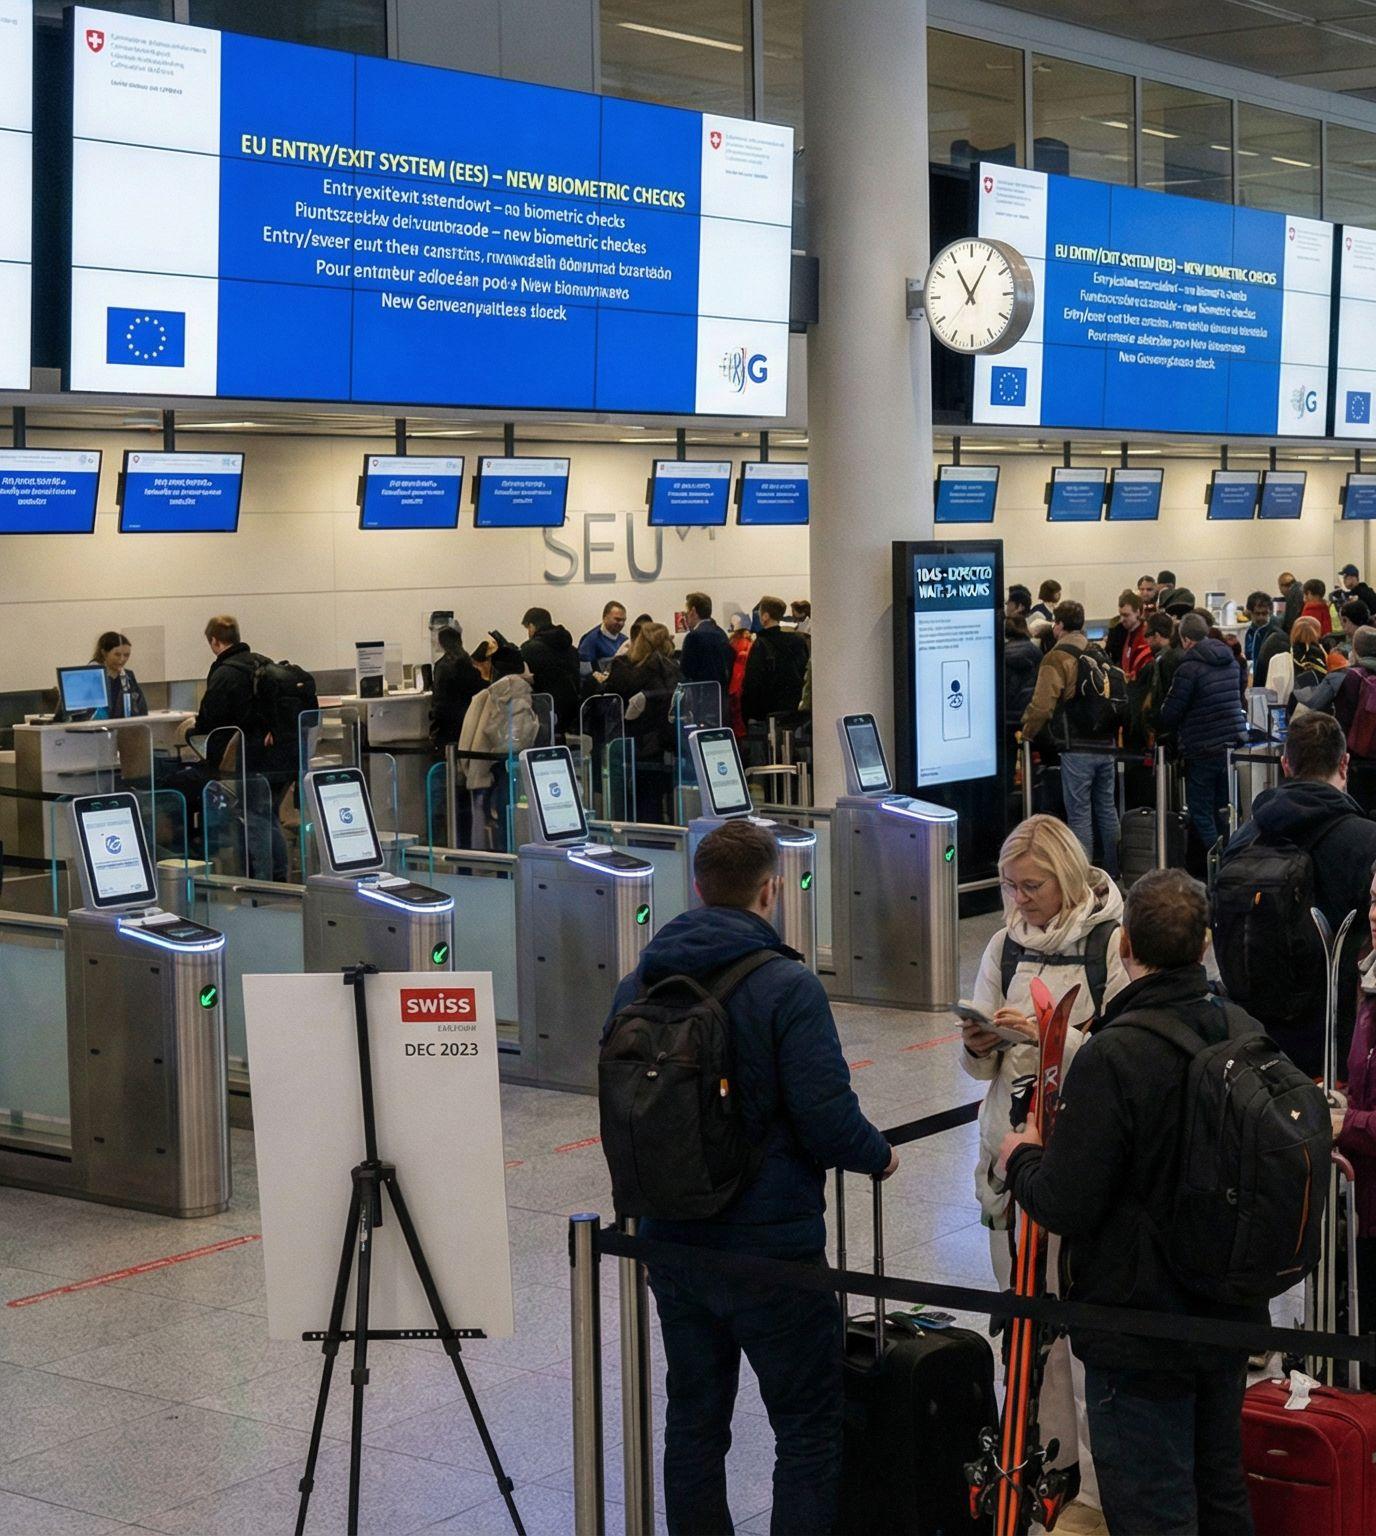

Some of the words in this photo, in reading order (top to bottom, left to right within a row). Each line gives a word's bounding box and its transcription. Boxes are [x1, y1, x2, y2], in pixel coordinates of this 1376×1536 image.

[241, 134, 267, 155] EU
[272, 139, 376, 169] ENTRY/EXIT
[379, 152, 445, 178] SYSTEM
[449, 160, 489, 187] (EES)
[506, 170, 545, 190] NEW
[547, 175, 631, 201] BIOMETRIC
[633, 186, 686, 208] CHECKS
[524, 201, 583, 225] biometric
[586, 212, 626, 229] checks
[504, 230, 531, 243] new
[316, 260, 350, 277] Pour
[381, 292, 413, 310] New
[405, 1043, 436, 1057] DEC
[440, 1042, 478, 1057] 2023
